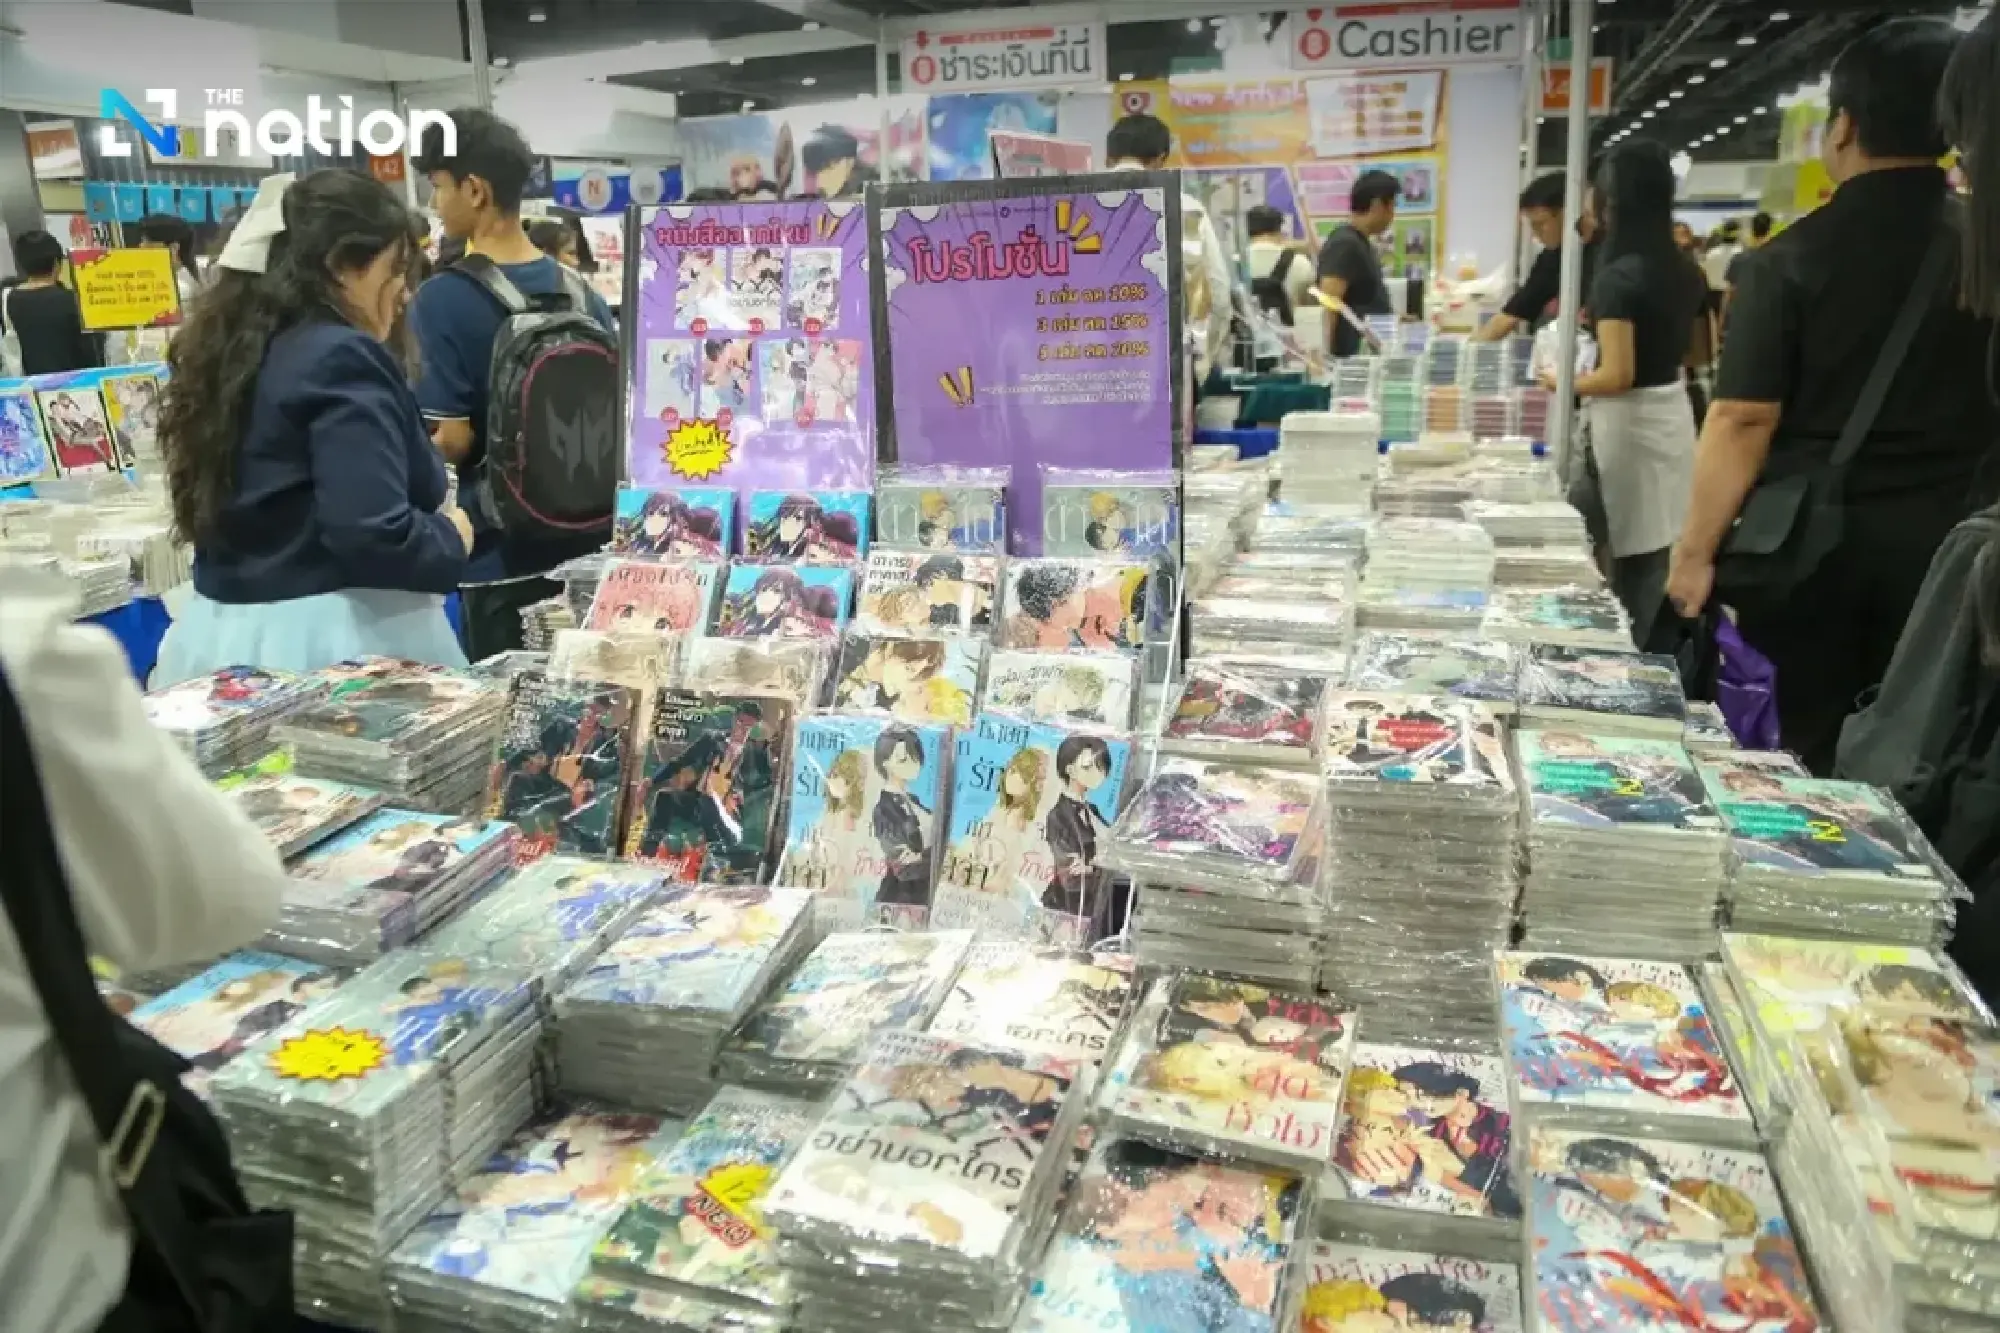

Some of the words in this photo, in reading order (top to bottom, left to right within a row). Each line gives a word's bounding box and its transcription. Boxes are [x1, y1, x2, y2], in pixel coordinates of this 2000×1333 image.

[939, 26, 1092, 82] ชำระเงินที่นี่
[1337, 15, 1516, 58] Cashier
[906, 223, 1070, 284] โปรโมชั่น
[1108, 283, 1149, 301] 10%
[812, 1128, 1026, 1190] อย่าบอกใคร
